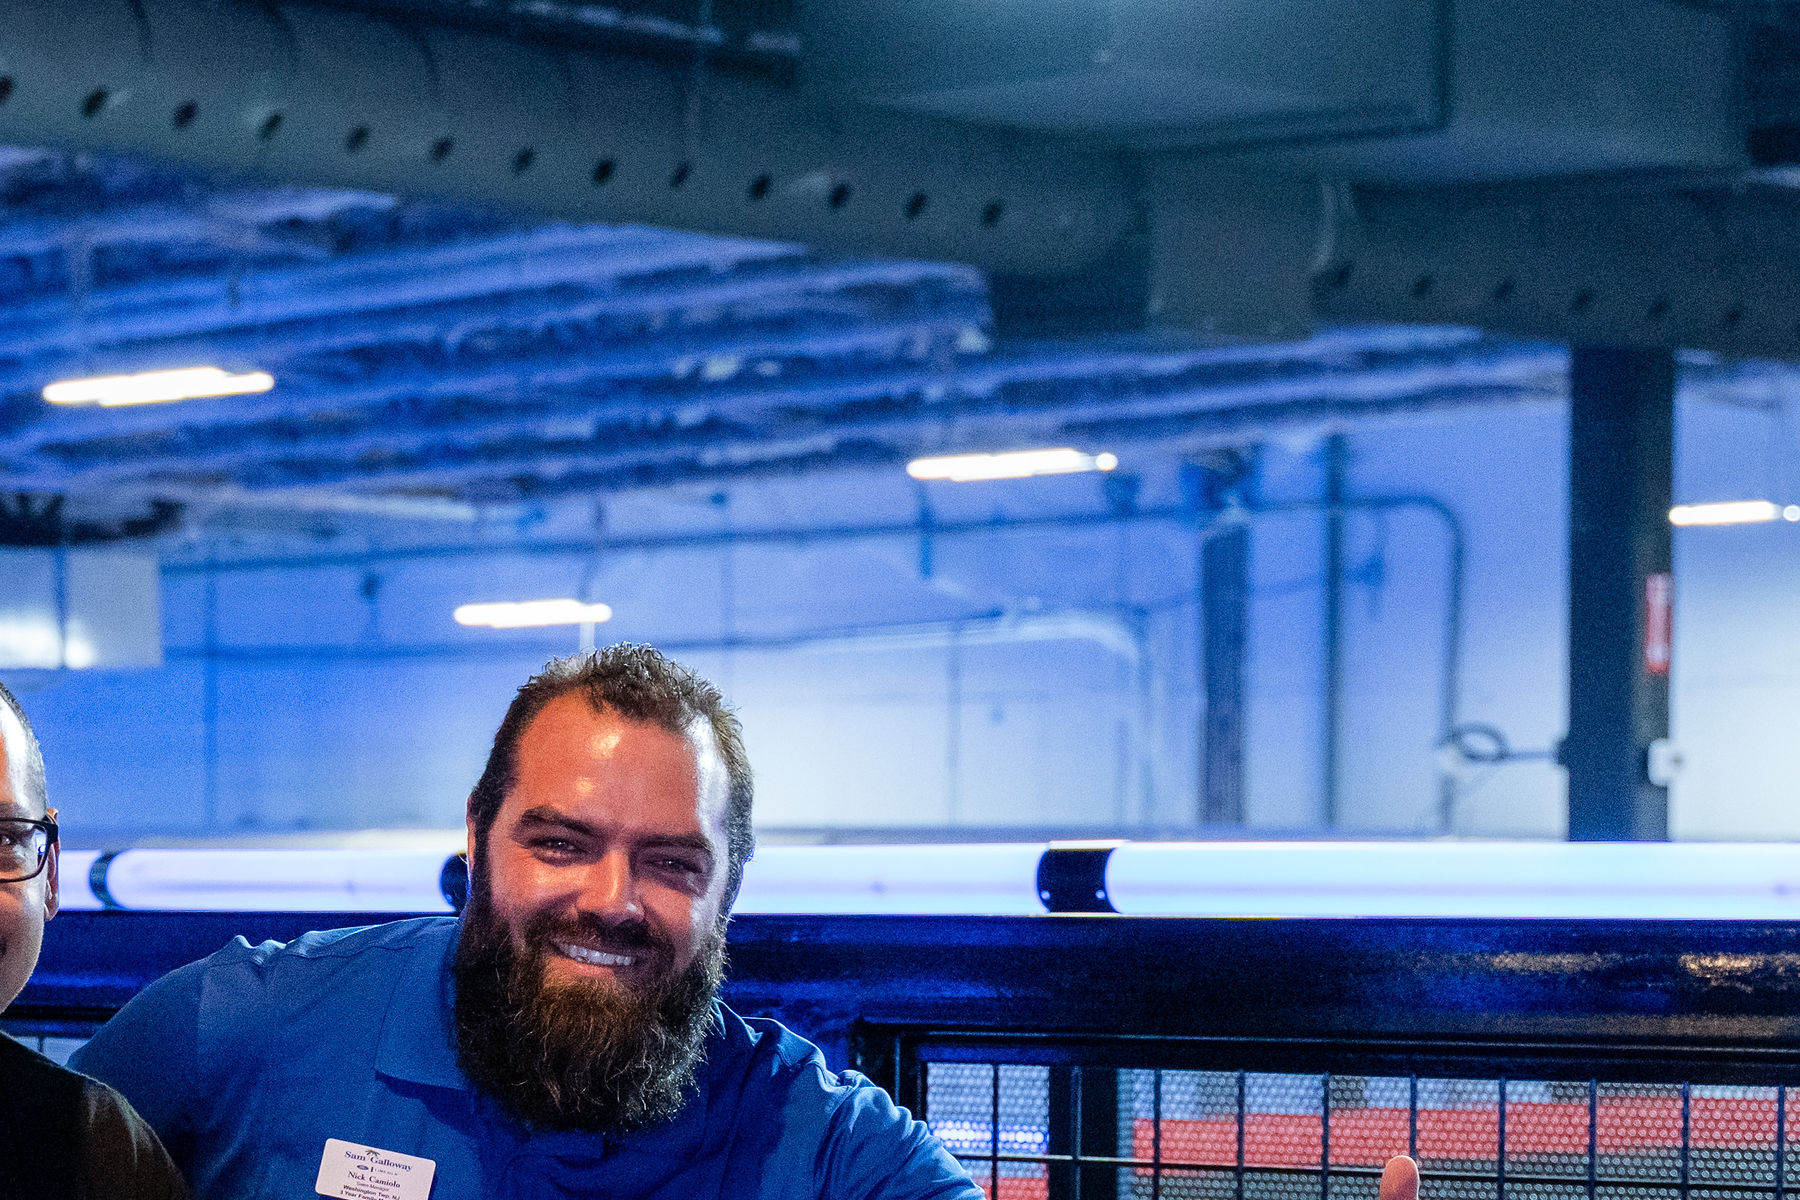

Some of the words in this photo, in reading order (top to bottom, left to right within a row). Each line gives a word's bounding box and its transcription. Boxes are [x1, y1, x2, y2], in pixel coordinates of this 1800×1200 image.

[344, 1151, 366, 1162] Sam
[370, 1156, 413, 1172] Galloway
[348, 1171, 366, 1181] Nick
